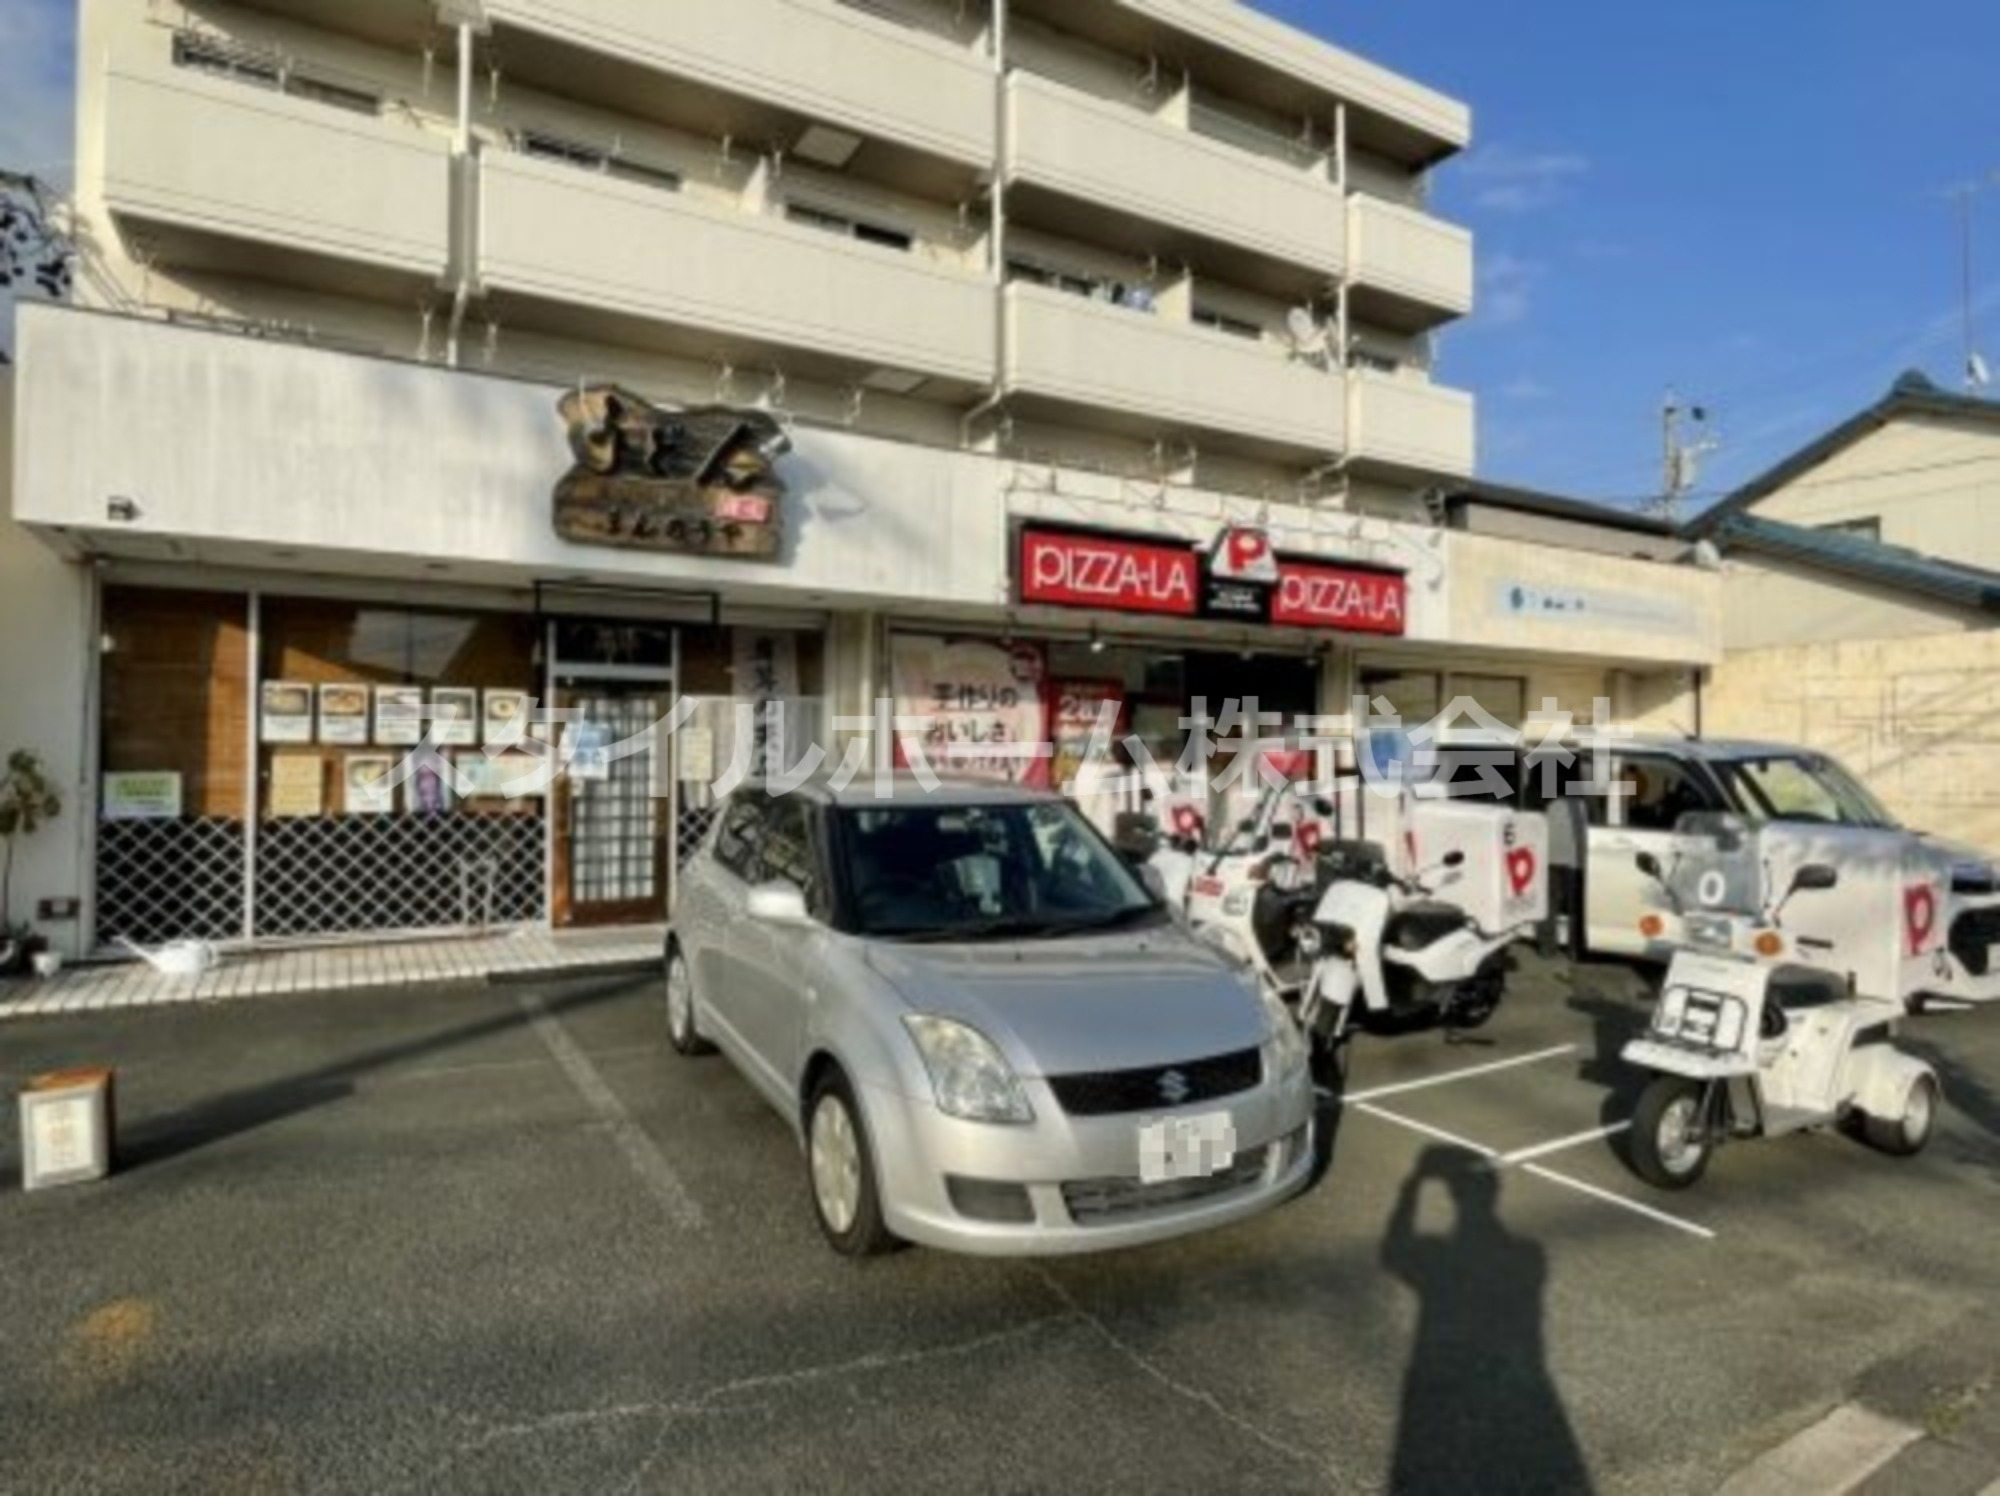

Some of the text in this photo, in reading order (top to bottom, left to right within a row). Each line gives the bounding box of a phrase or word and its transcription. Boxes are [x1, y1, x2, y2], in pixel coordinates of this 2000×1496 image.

[1032, 545, 1192, 602] PIZZA-LA
[1279, 574, 1402, 621] PIZZA-LA
[932, 682, 1019, 709] 手作りの
